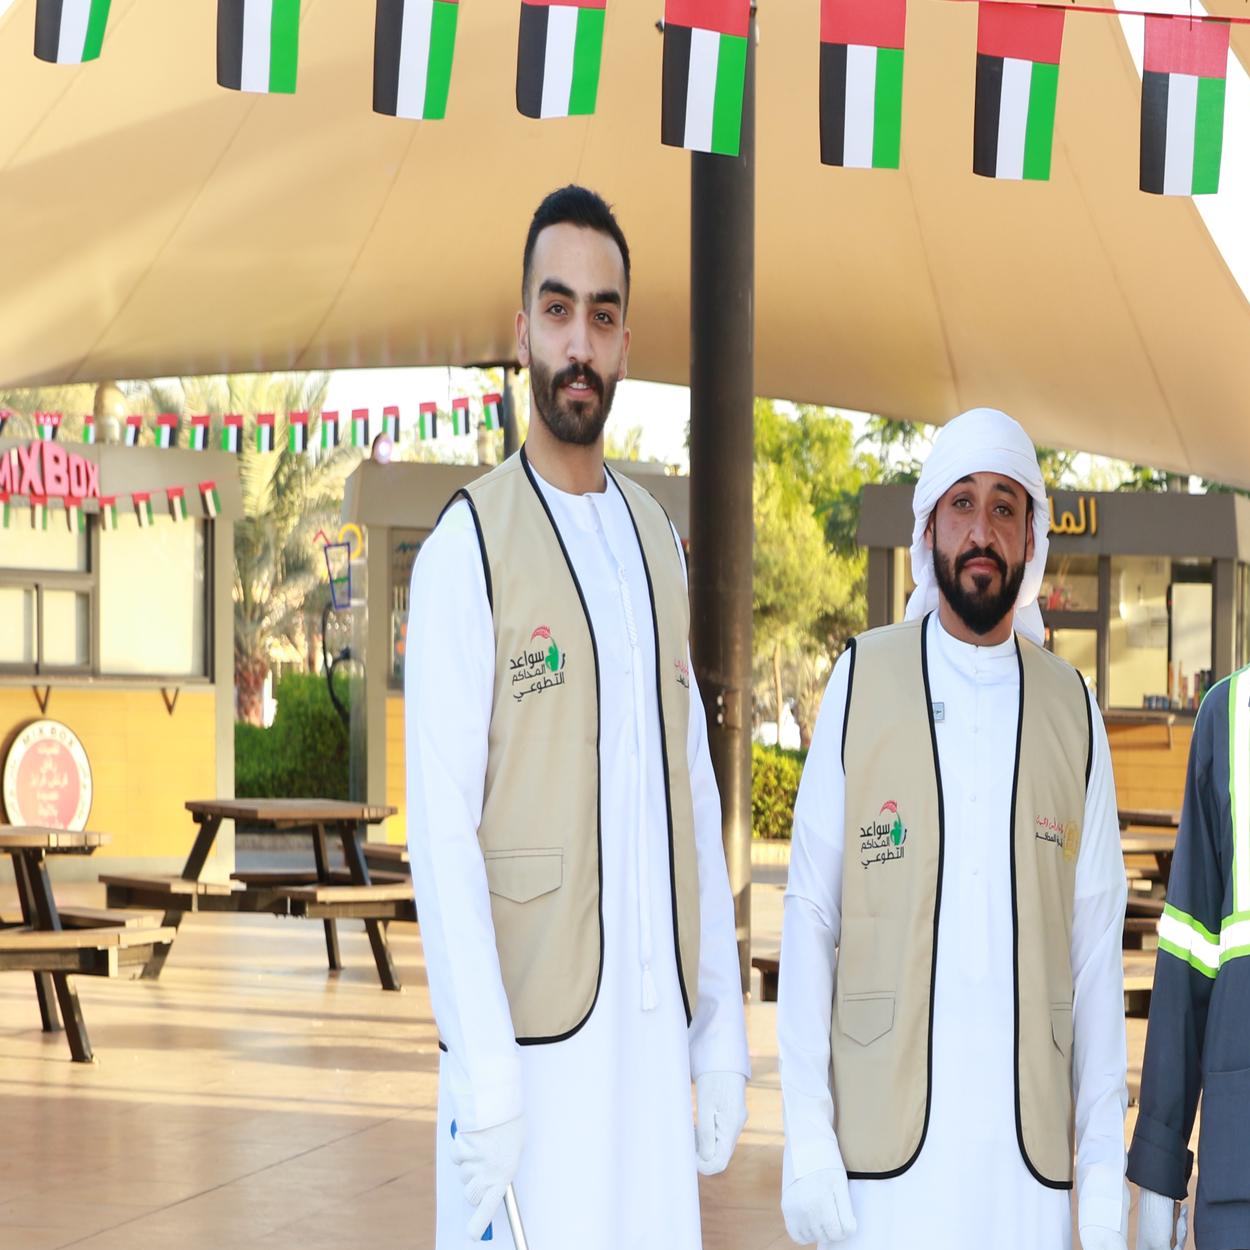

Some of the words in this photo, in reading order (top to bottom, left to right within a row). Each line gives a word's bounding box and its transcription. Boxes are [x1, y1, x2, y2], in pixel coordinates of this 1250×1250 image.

[509, 650, 545, 670] سواعد
[513, 671, 566, 702] التطوعي
[859, 821, 890, 838] سواعد
[861, 847, 905, 870] التطوعي
